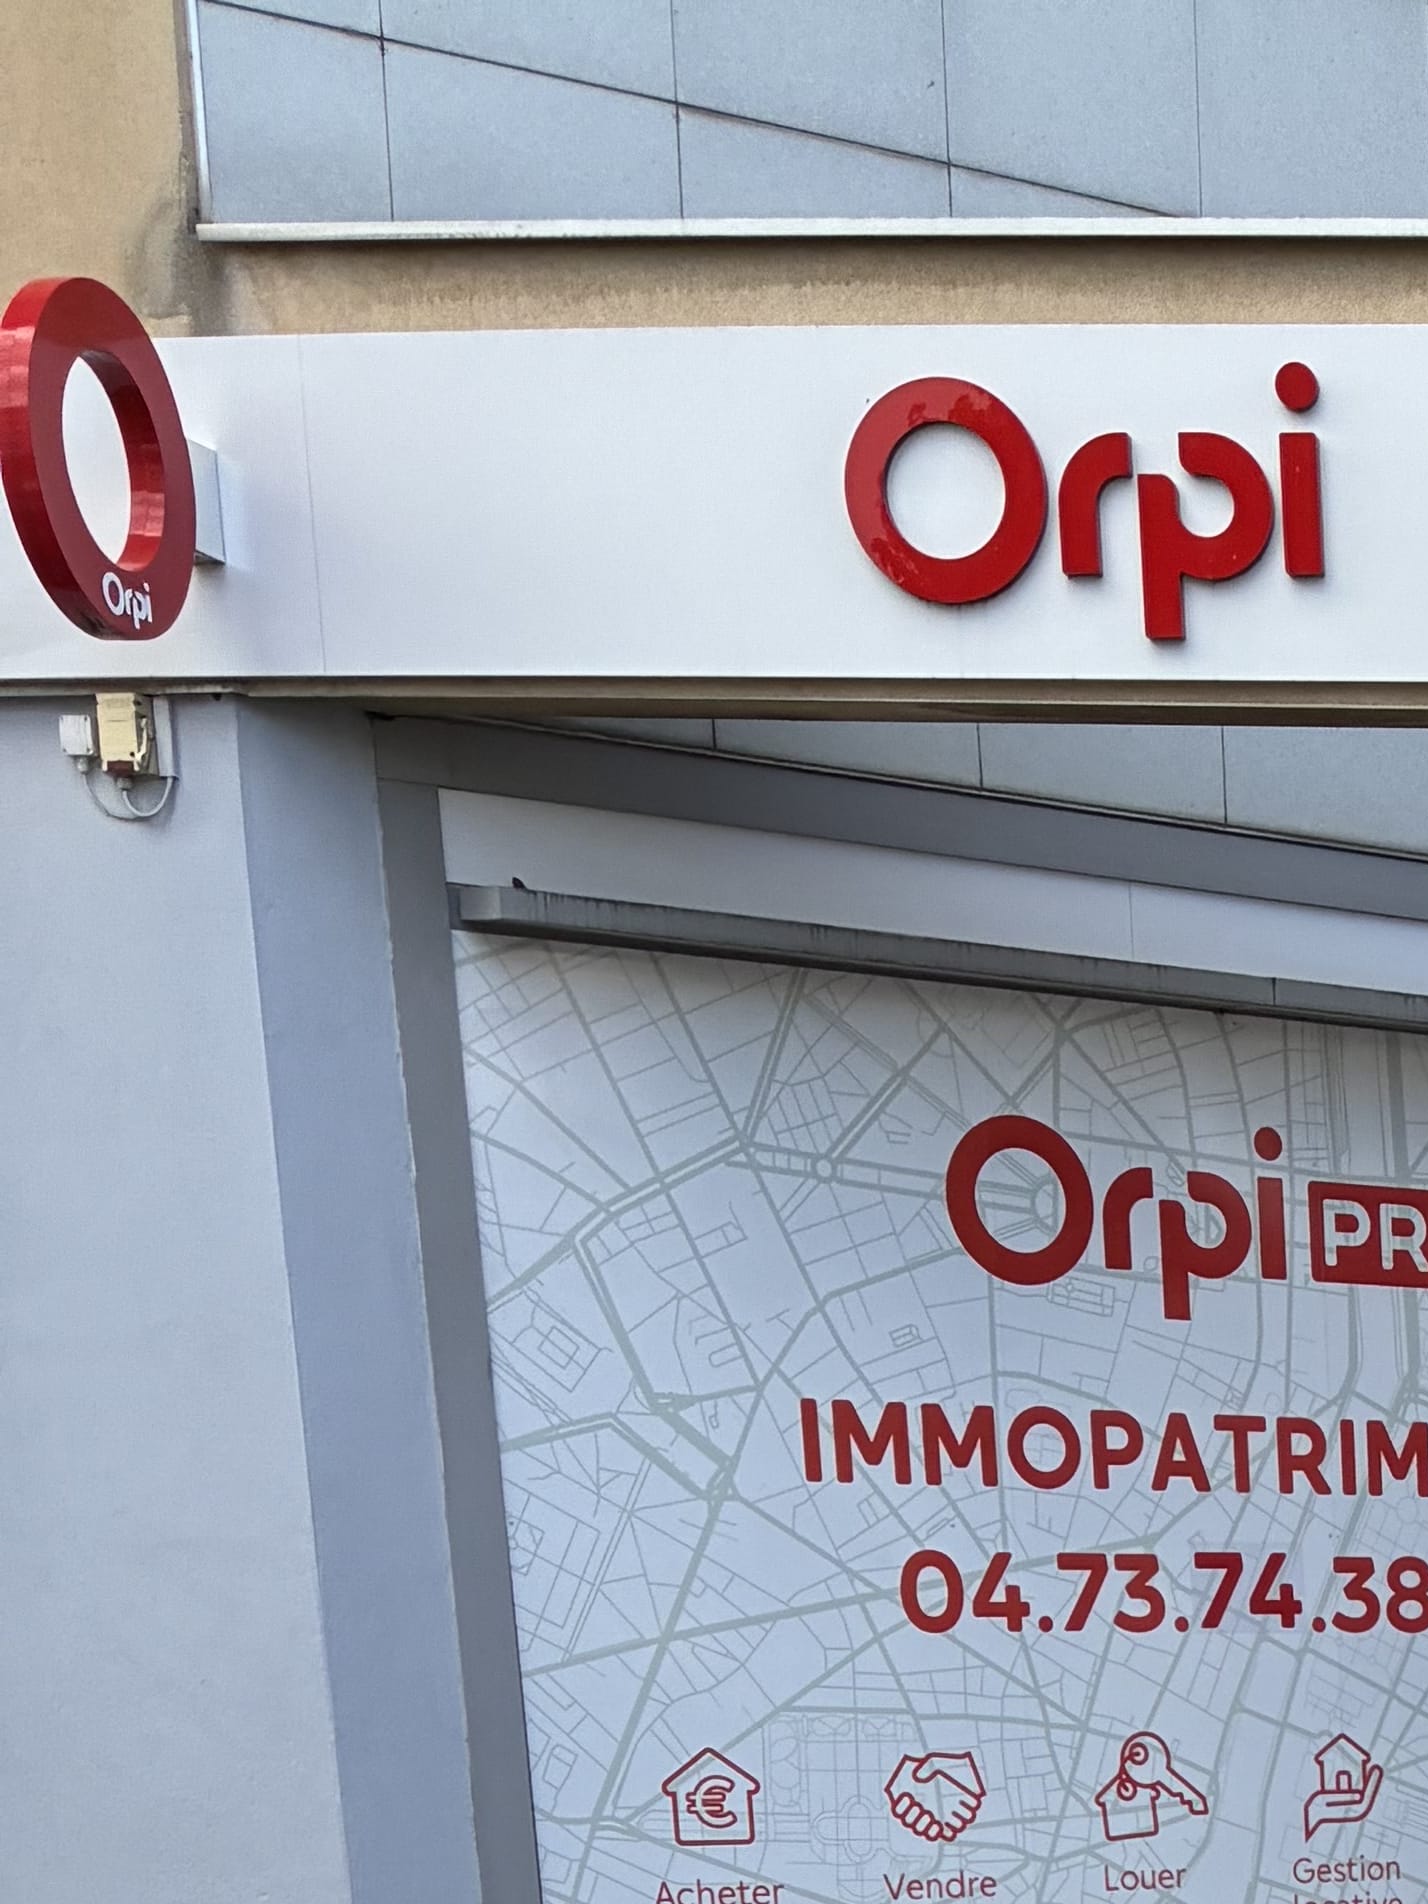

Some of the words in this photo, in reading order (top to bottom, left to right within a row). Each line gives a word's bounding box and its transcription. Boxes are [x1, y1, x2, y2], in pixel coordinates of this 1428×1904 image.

[844, 361, 1325, 642] Orpi
[101, 571, 153, 630] Orpi
[945, 1114, 1288, 1321] Orpi
[883, 1869, 998, 1901] Vendre
[1104, 1864, 1187, 1892] Louer
[1292, 1854, 1402, 1885] Gestion
